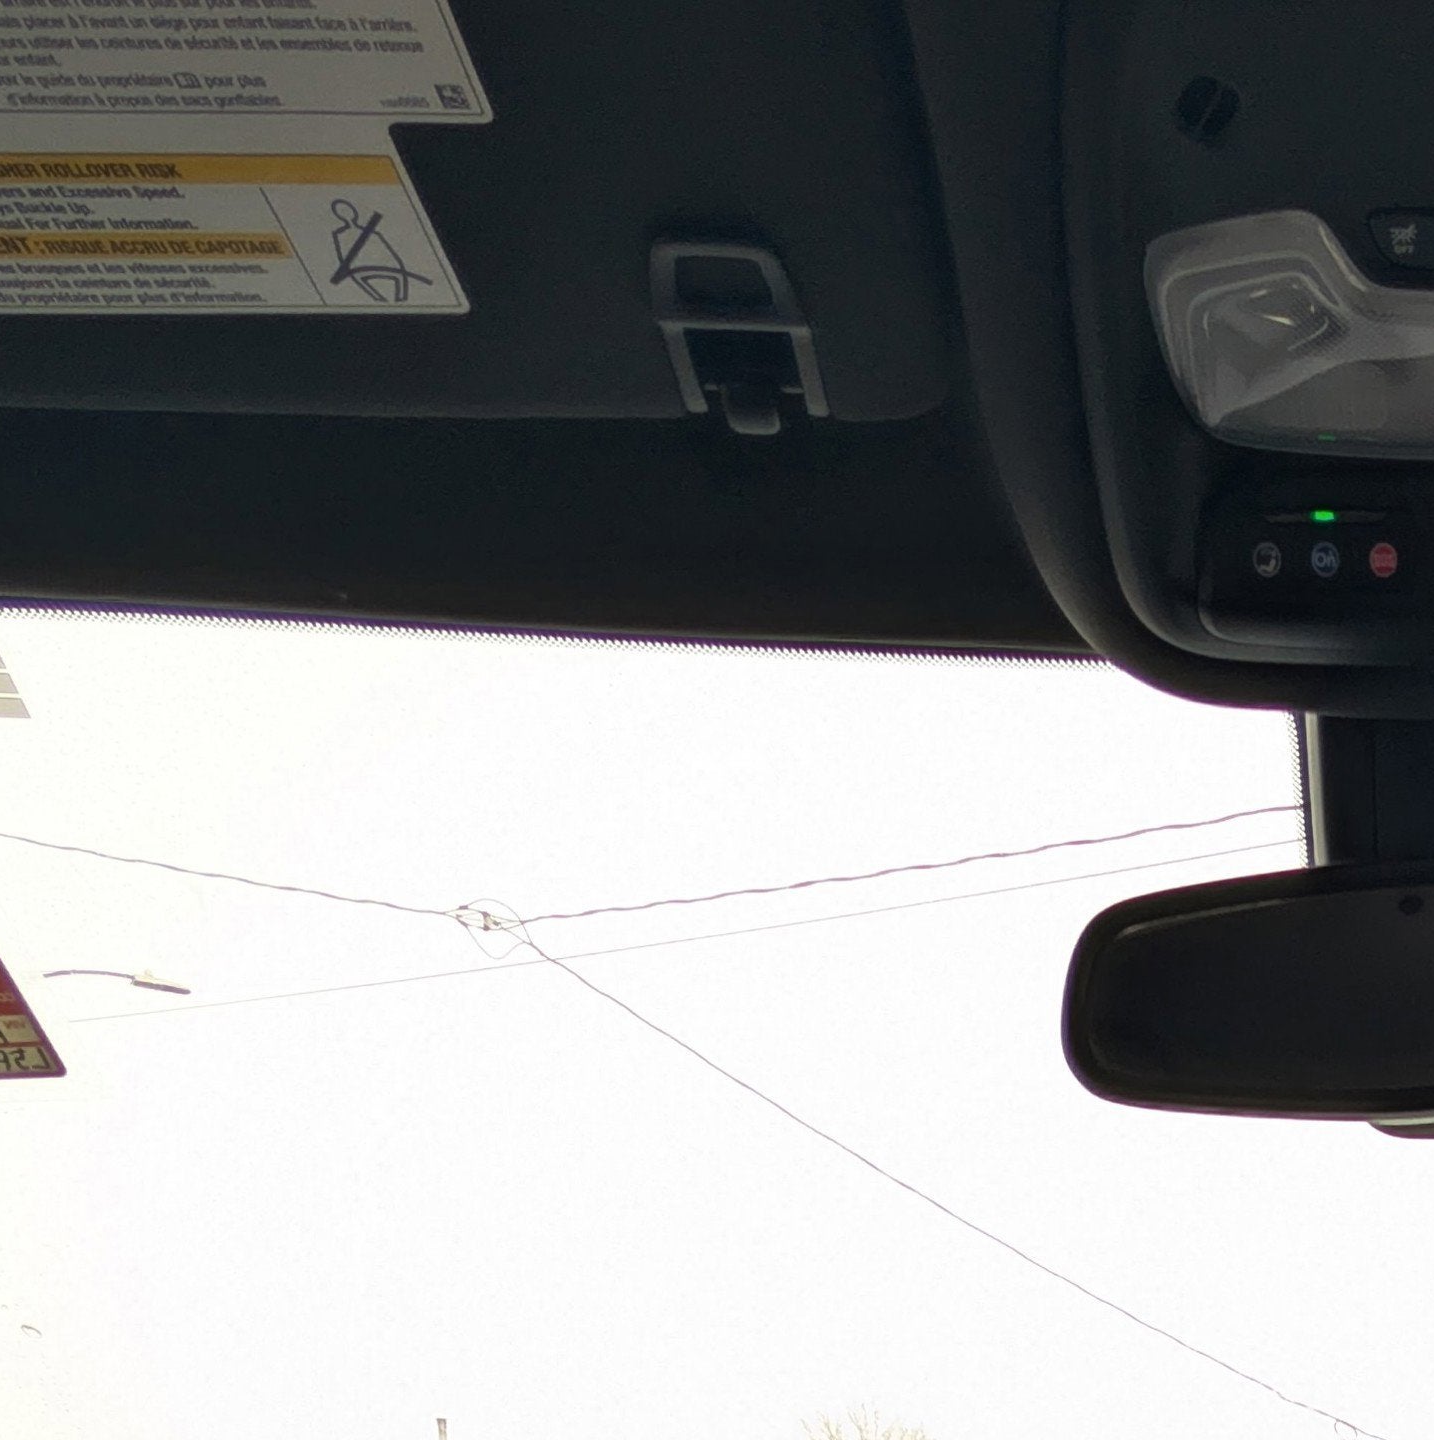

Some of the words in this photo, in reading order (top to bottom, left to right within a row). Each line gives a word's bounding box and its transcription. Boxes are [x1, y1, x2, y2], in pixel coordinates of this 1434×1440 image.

[41, 163, 134, 178] ROLLOVER
[135, 163, 183, 179] RISK
[27, 186, 57, 198] and
[57, 186, 131, 198] Excessive
[132, 186, 184, 200] Speed.
[13, 201, 66, 214] Buckle
[66, 201, 94, 216] Up.
[24, 217, 50, 230] For
[51, 217, 105, 230] Further
[108, 217, 196, 230] Information.
[42, 240, 108, 254] RISQUE
[109, 240, 168, 254] ACCRU
[194, 240, 284, 254] CAPOTAGE
